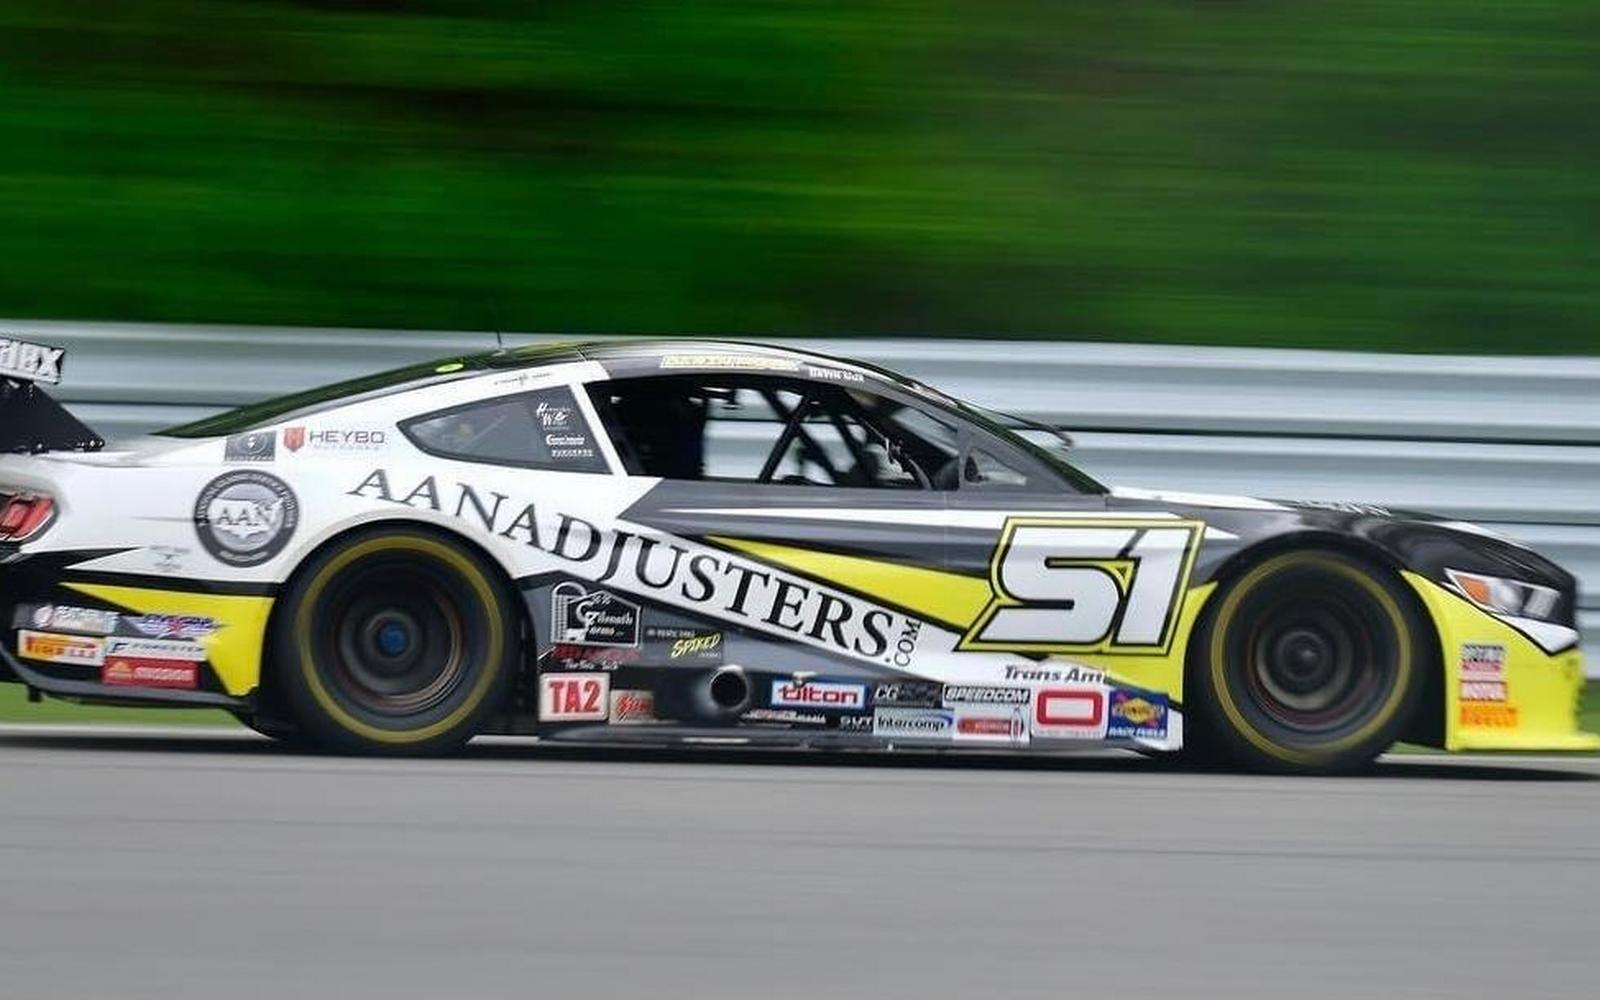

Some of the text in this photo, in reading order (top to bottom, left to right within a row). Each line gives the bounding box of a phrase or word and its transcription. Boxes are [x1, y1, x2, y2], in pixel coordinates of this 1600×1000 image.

[310, 430, 385, 445] HEYBO
[346, 468, 894, 657] AANADJUSTERS
[966, 521, 1199, 651] 51
[671, 633, 721, 659] SPIKED
[1004, 665, 1060, 681] Trans
[549, 680, 602, 714] TA2
[778, 684, 858, 704] tilton
[945, 686, 1029, 703] SPEEDCOM
[878, 717, 944, 732] Intercomp
